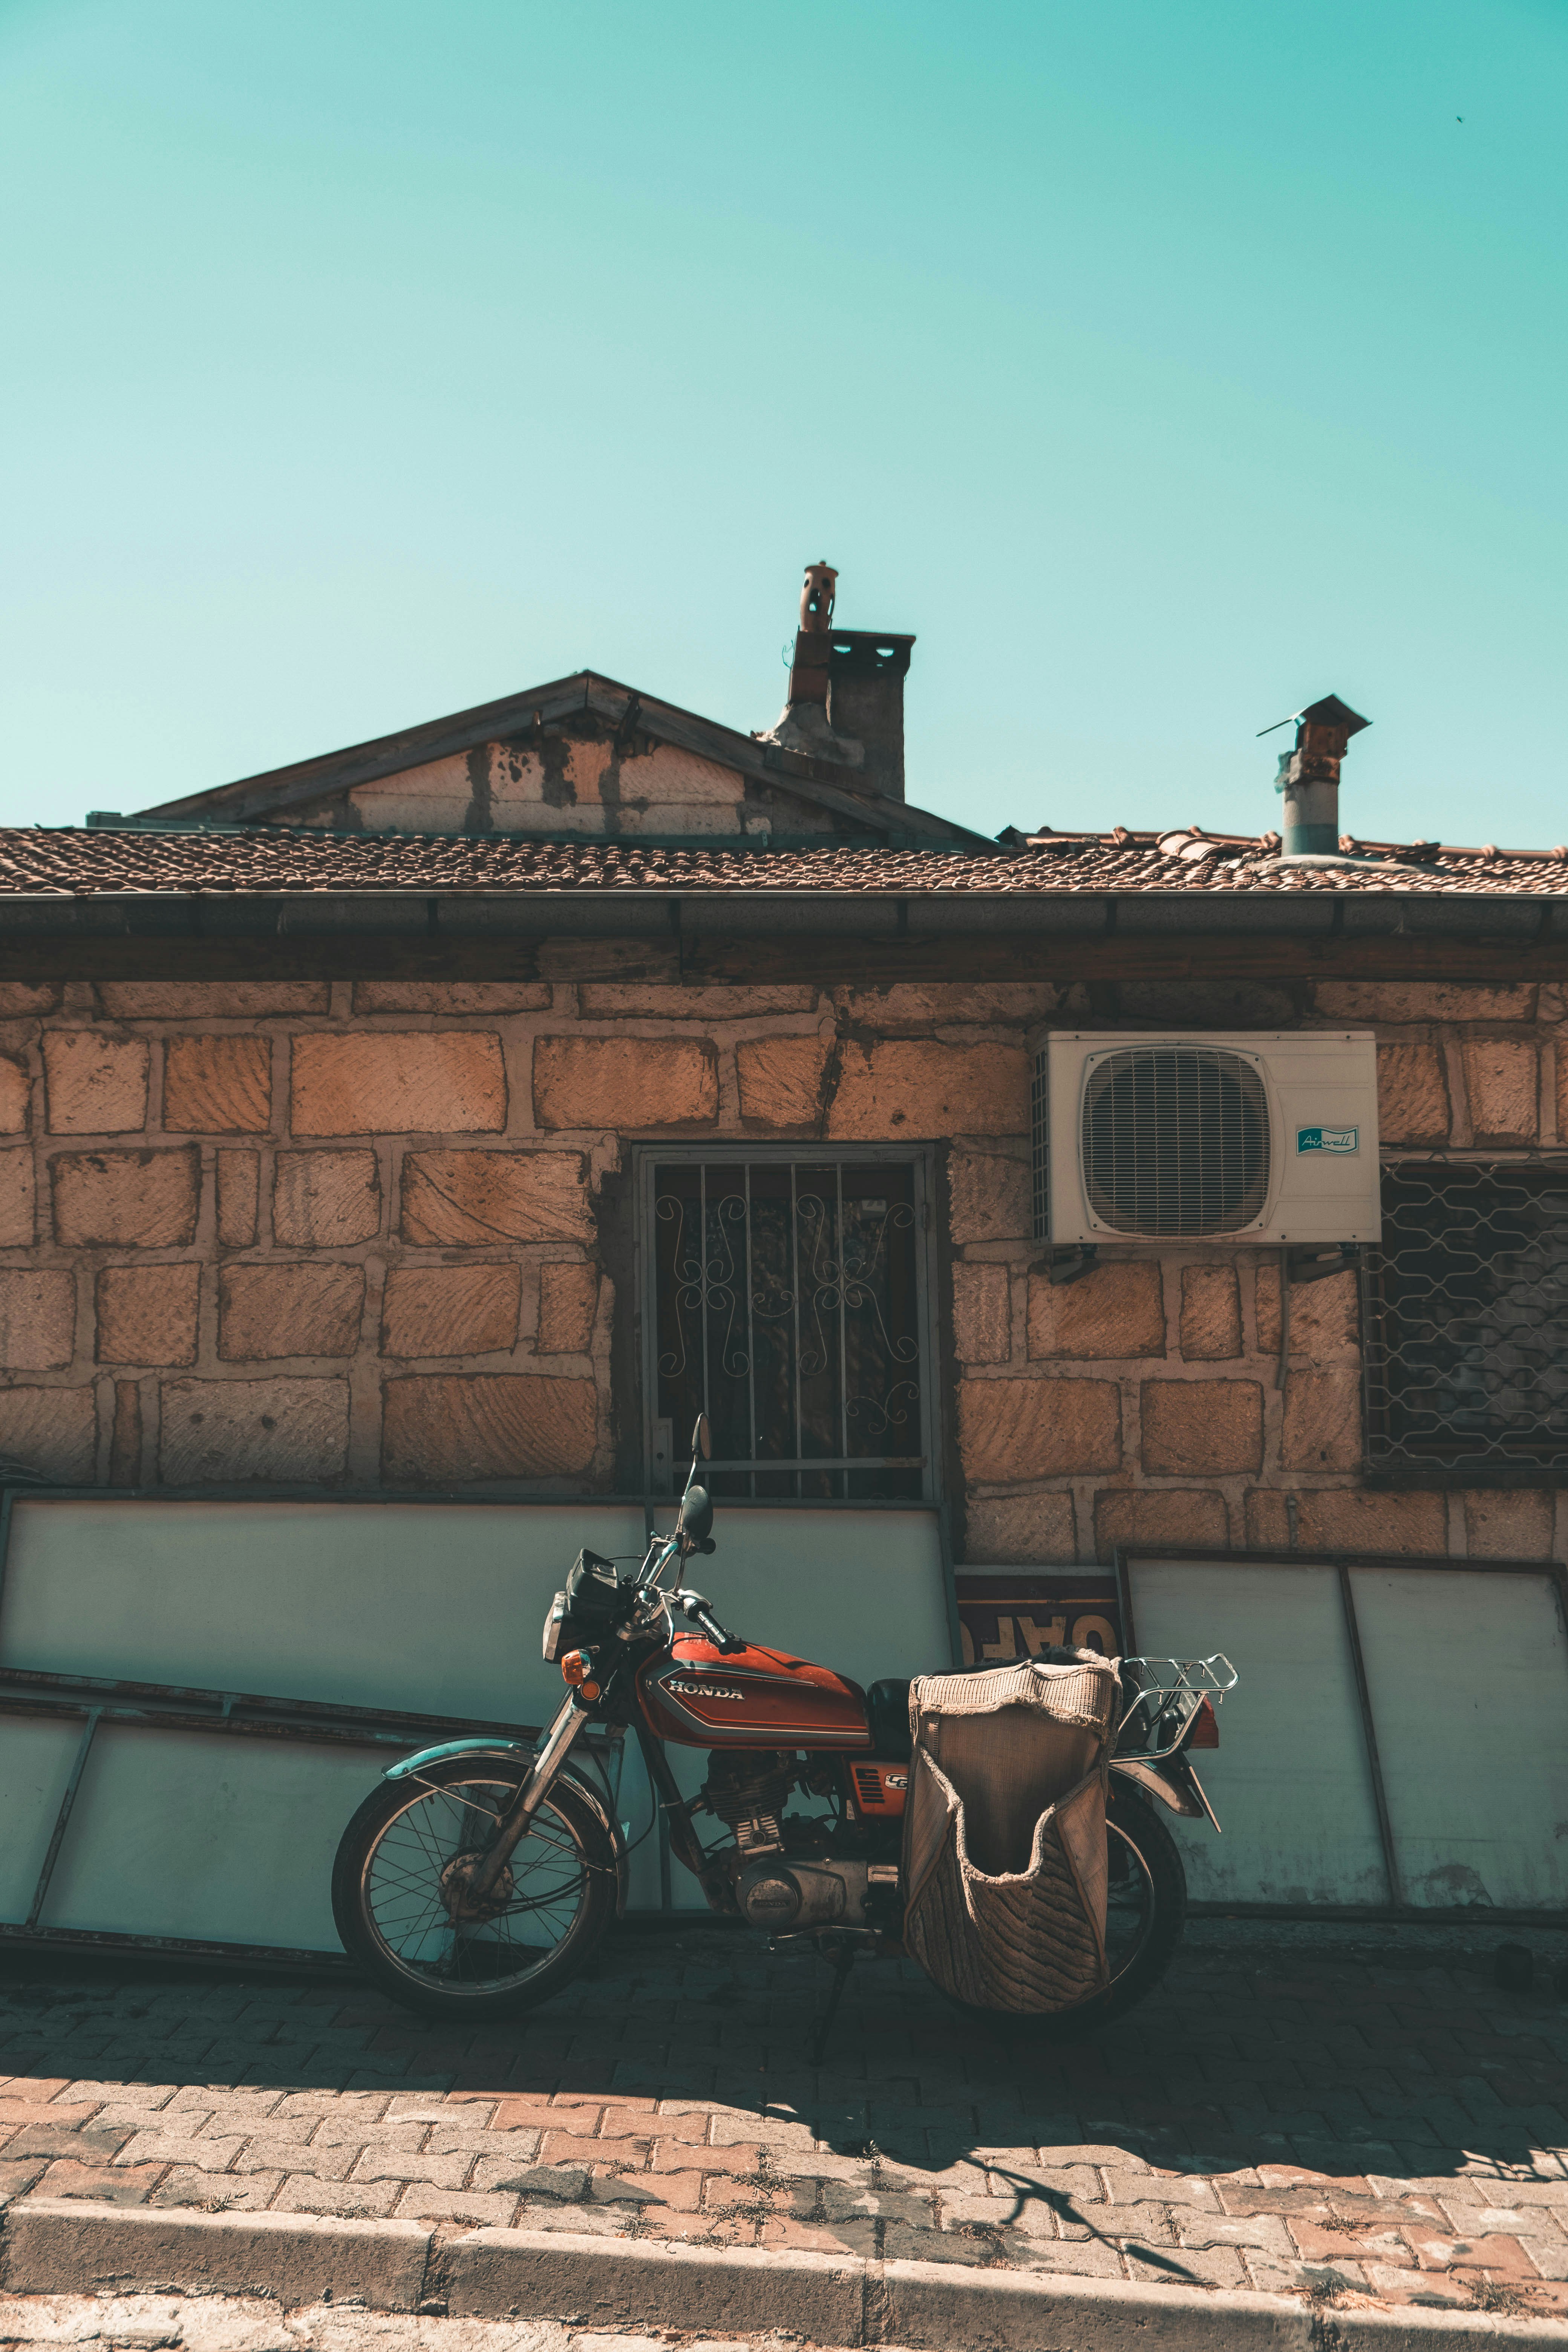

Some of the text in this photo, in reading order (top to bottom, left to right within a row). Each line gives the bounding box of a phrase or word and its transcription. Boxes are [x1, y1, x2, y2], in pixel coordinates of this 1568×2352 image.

[1302, 1135, 1350, 1146] Airwell
[960, 1615, 1118, 1665] AF
[669, 1680, 745, 1701] HONDA
